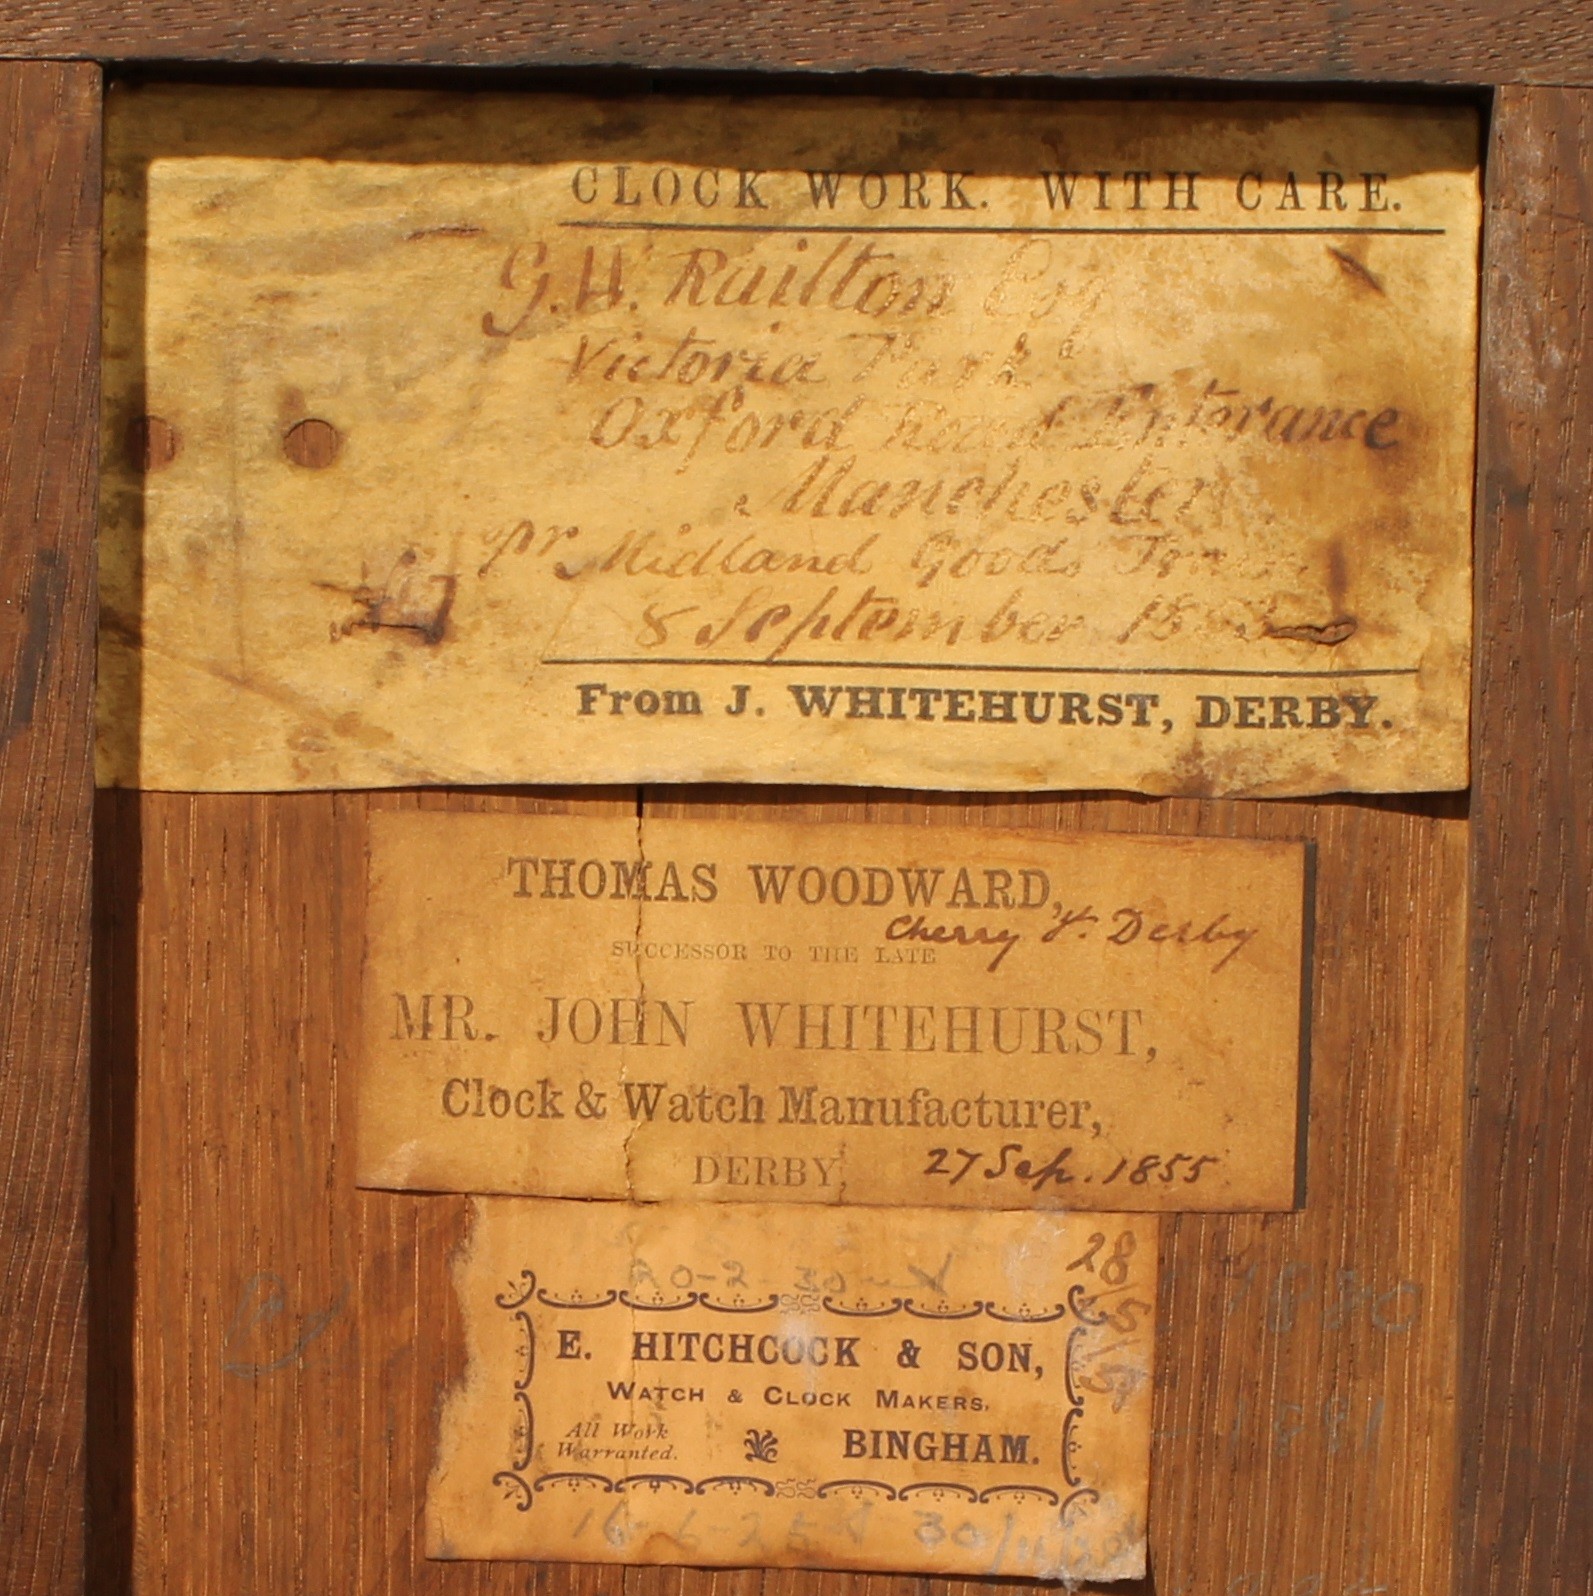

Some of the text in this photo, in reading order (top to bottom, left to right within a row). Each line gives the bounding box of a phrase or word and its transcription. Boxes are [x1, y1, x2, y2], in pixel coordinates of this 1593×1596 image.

[571, 165, 1402, 213] CLOCK WORK. WITH CARE.
[662, 235, 956, 319] Railton
[565, 321, 828, 385] Victoria
[588, 384, 853, 475] Oxford
[553, 522, 881, 582] Midland
[693, 585, 1085, 663] September
[575, 682, 1394, 734] From J. WHITEHURST, DERBY.
[506, 856, 1064, 922] THOMAS WOODWARD,
[610, 939, 938, 967] SUCCESSOR TO THE LATE
[1106, 907, 1262, 975] Derby
[388, 991, 1159, 1066] MR. JOHN WHITEHURST,
[441, 1077, 1102, 1139] Clock & Watch Manufacturer,
[923, 1146, 984, 1185] 27
[1101, 1153, 1219, 1186] 1855
[555, 1329, 1045, 1381] E. HITCHCOCK & SON,
[726, 1388, 744, 1404] &
[556, 1441, 679, 1463] Warranted.
[565, 1421, 670, 1440] All Work
[842, 1427, 1041, 1466] BINGHAM.
